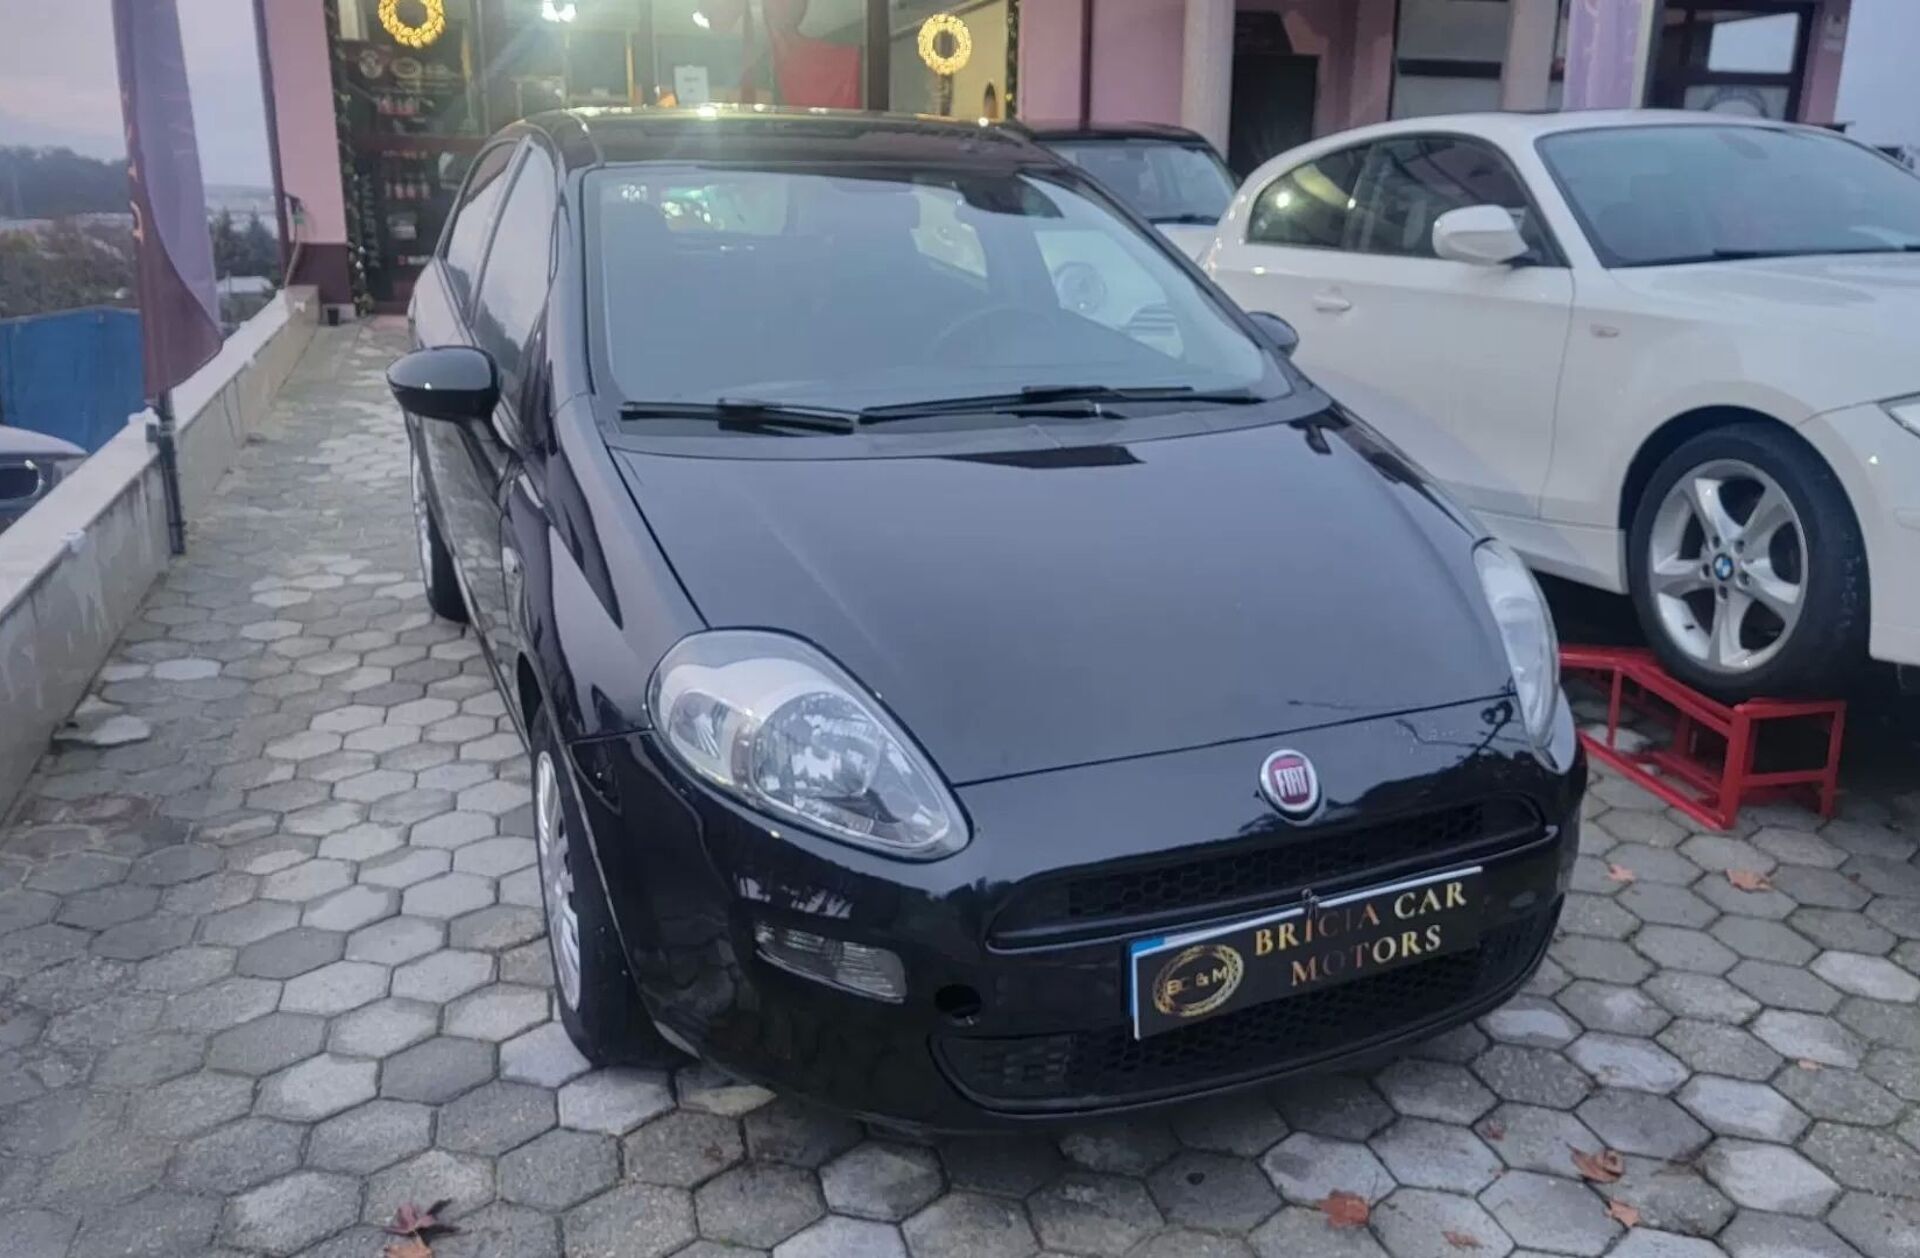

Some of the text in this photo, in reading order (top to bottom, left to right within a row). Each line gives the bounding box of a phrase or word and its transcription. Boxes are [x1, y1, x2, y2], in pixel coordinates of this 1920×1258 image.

[1274, 766, 1308, 798] FIAT
[1394, 881, 1467, 920] CAR
[1291, 924, 1441, 987] MOTORS
